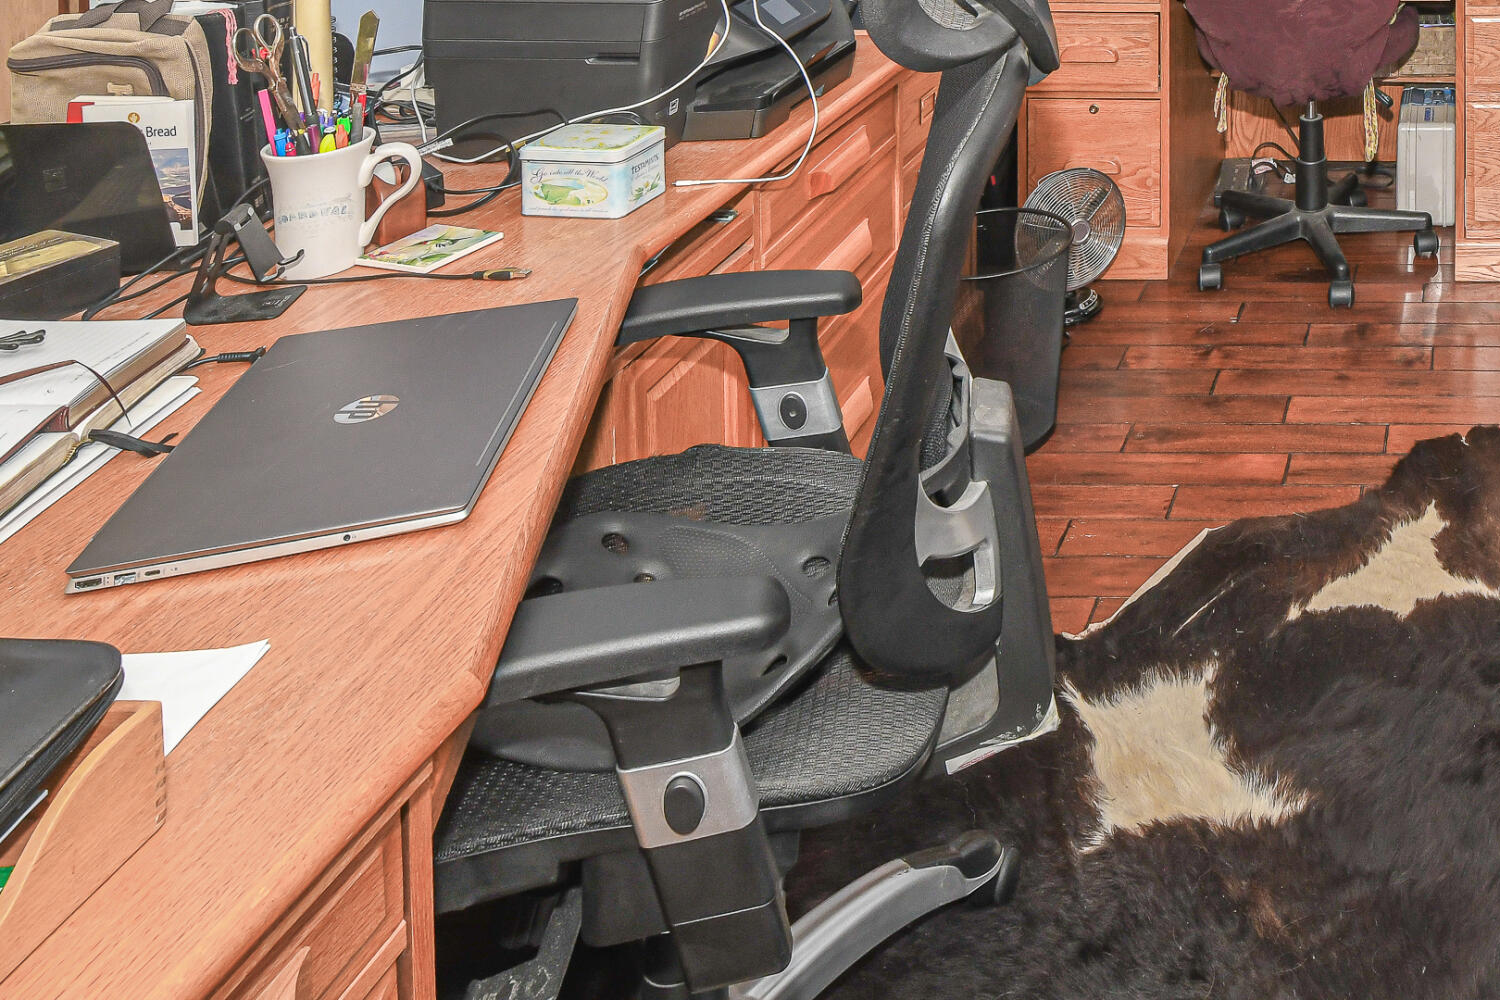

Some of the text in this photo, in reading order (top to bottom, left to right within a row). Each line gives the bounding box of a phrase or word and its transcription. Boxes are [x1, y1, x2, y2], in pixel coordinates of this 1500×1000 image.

[145, 126, 177, 138] Bread
[530, 167, 609, 184] Go into all the World
